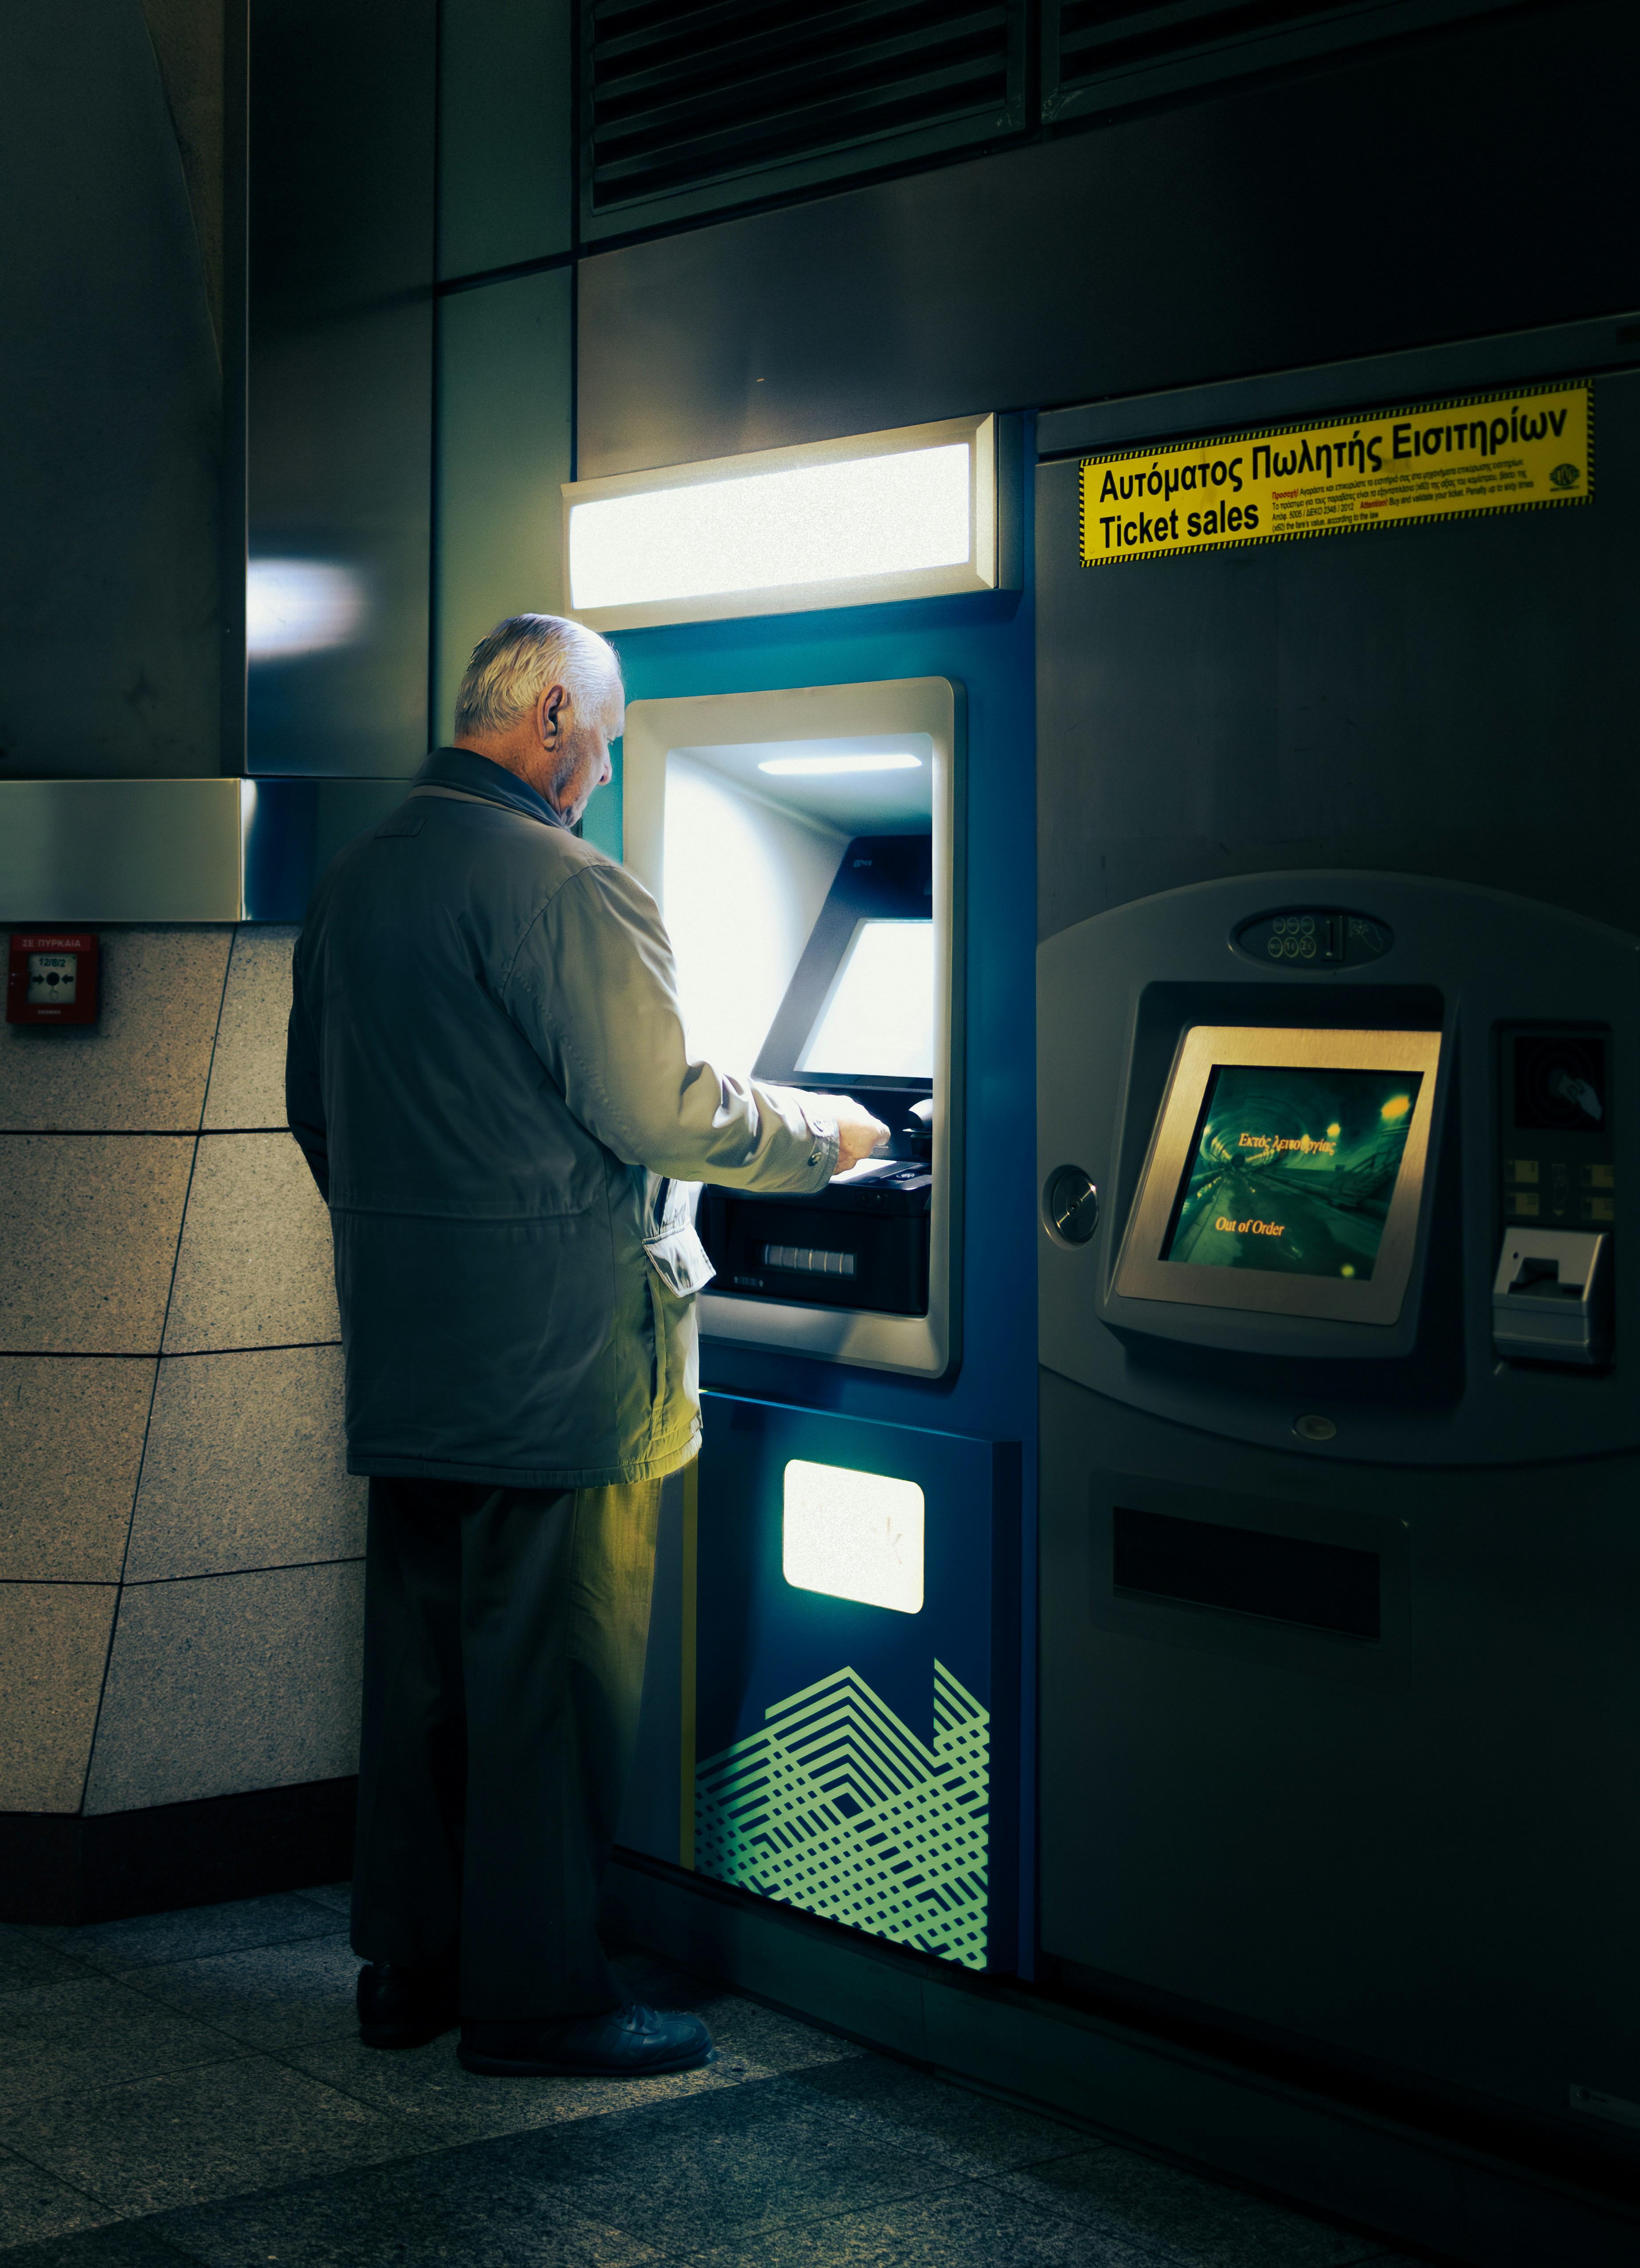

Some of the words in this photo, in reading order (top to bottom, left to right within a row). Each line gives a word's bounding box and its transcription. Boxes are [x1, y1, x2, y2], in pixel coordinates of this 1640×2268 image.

[1099, 457, 1244, 503] Αυτόματος
[1252, 430, 1383, 480] Πωλητής
[1392, 406, 1568, 460] Εισιτηρίων
[1360, 498, 1388, 509] Attention!
[1389, 497, 1399, 506] Buy
[1401, 496, 1412, 504] and
[1435, 492, 1447, 501] your
[1099, 508, 1179, 548] Ticket
[1186, 500, 1260, 537] sales
[1327, 515, 1352, 524] according
[22, 939, 34, 947] ΣΕ
[38, 939, 81, 947] ΠΥΡΚΑΙΑ
[39, 958, 66, 967] 12/8/2
[1238, 1133, 1272, 1151] Εκτός
[1215, 1216, 1237, 1232] Out
[1238, 1219, 1253, 1233] of
[1252, 1220, 1285, 1236] Order
